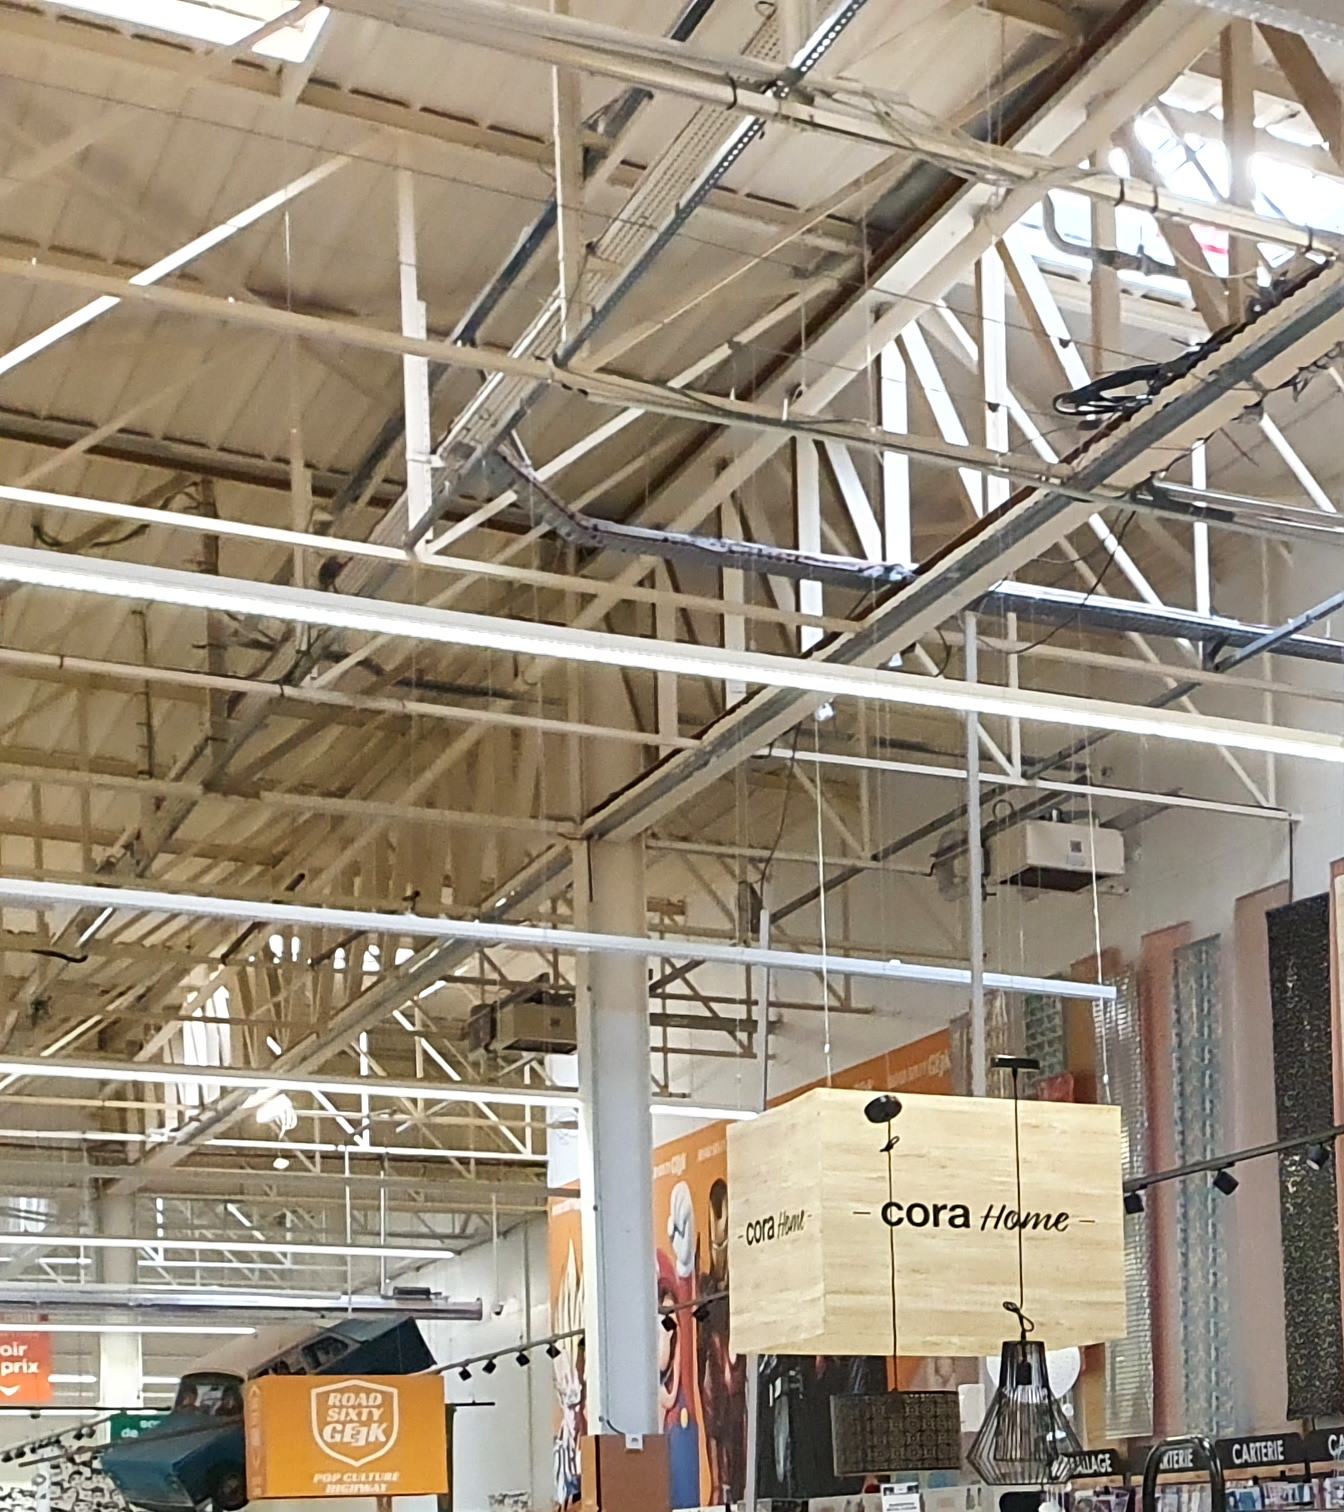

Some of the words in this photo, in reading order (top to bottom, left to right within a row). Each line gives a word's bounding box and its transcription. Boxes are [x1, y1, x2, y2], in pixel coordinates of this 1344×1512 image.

[881, 1201, 970, 1228] cora
[980, 1204, 1070, 1231] Home
[746, 1215, 775, 1245] cora
[777, 1209, 804, 1238] Home
[1, 1359, 39, 1376] prix
[328, 1392, 382, 1406] ROAD
[327, 1408, 384, 1421] SIXTY
[1232, 1440, 1284, 1465] CARTERIE
[313, 1472, 341, 1483] POP
[343, 1472, 400, 1482] CULTURE
[326, 1483, 388, 1493] HIGHWAY
